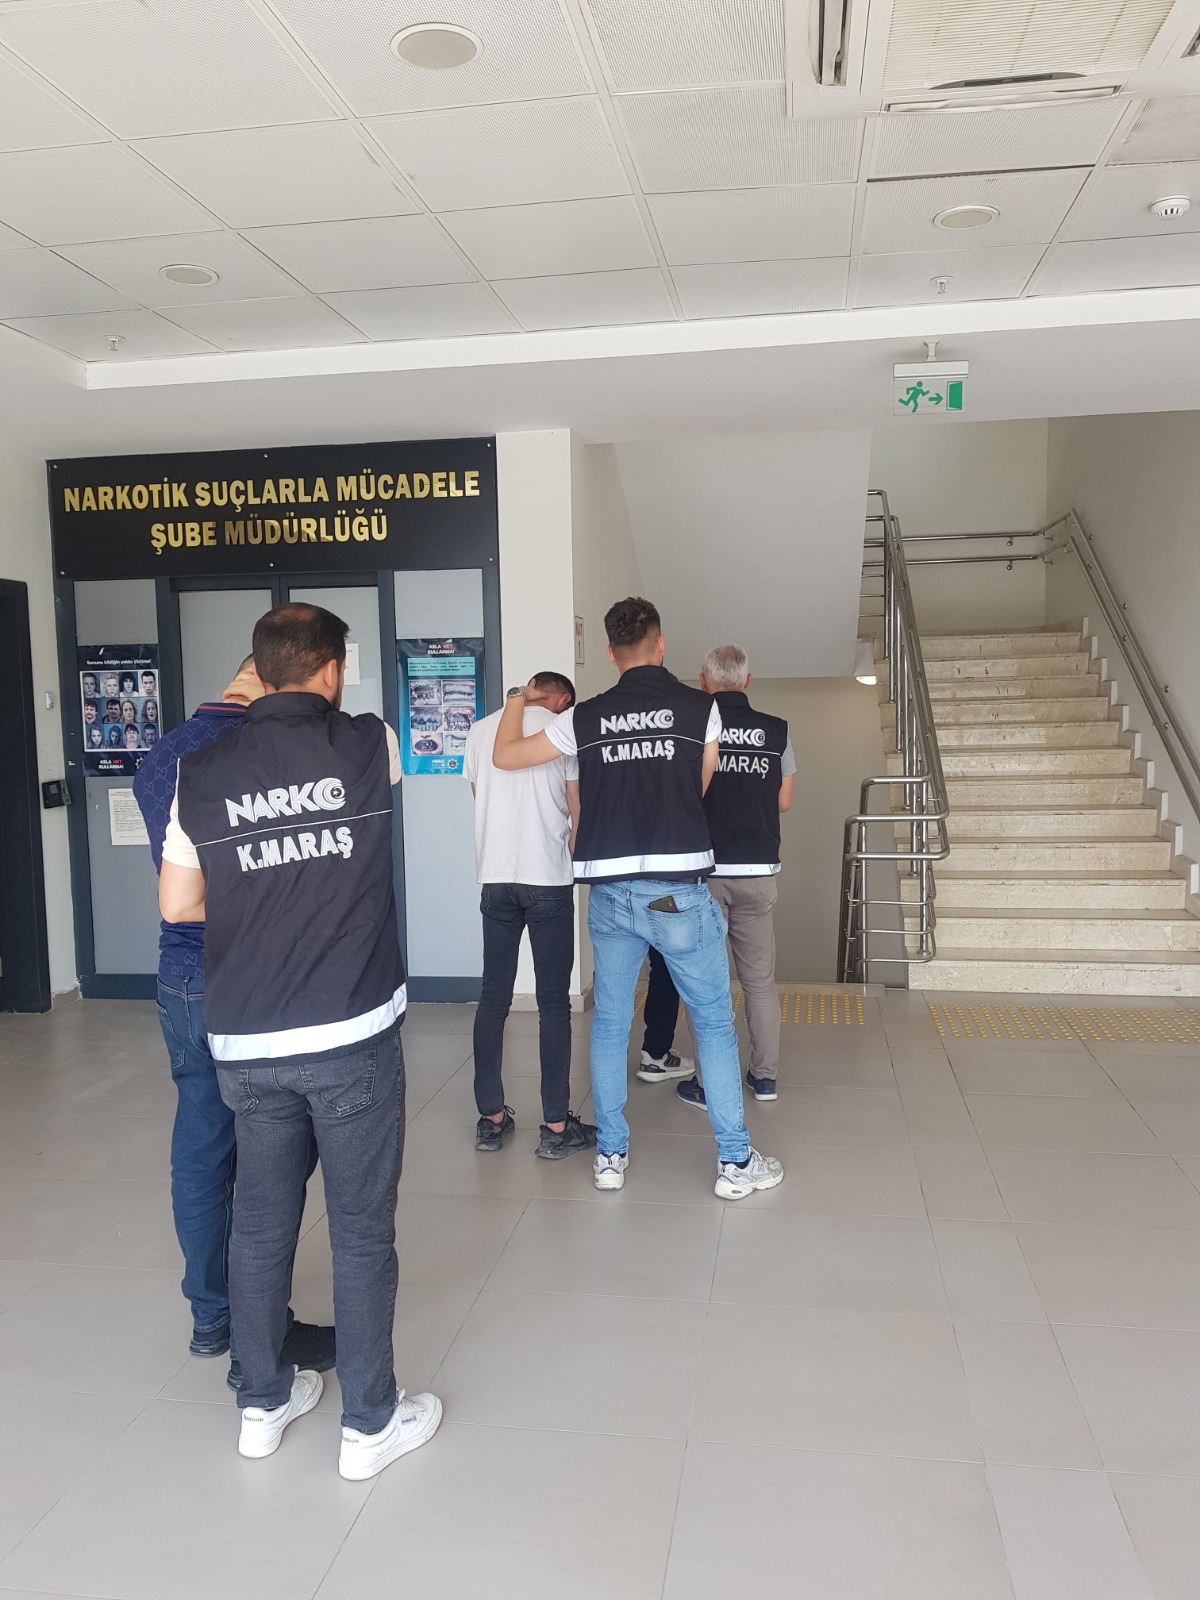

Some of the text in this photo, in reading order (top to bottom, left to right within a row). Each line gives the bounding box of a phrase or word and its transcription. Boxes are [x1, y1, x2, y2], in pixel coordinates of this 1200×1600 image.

[64, 468, 480, 512] NARKOTİK SUÇLARLA MÜCADELE
[151, 507, 388, 555] ŞUBE MÜDÜRLÜĞÜ
[600, 708, 675, 735] NARKO
[601, 739, 675, 764] K.MARAŞ
[714, 754, 770, 780] MARAŞ
[225, 777, 347, 828] NARKO
[236, 826, 354, 872] K.MARAŞ
